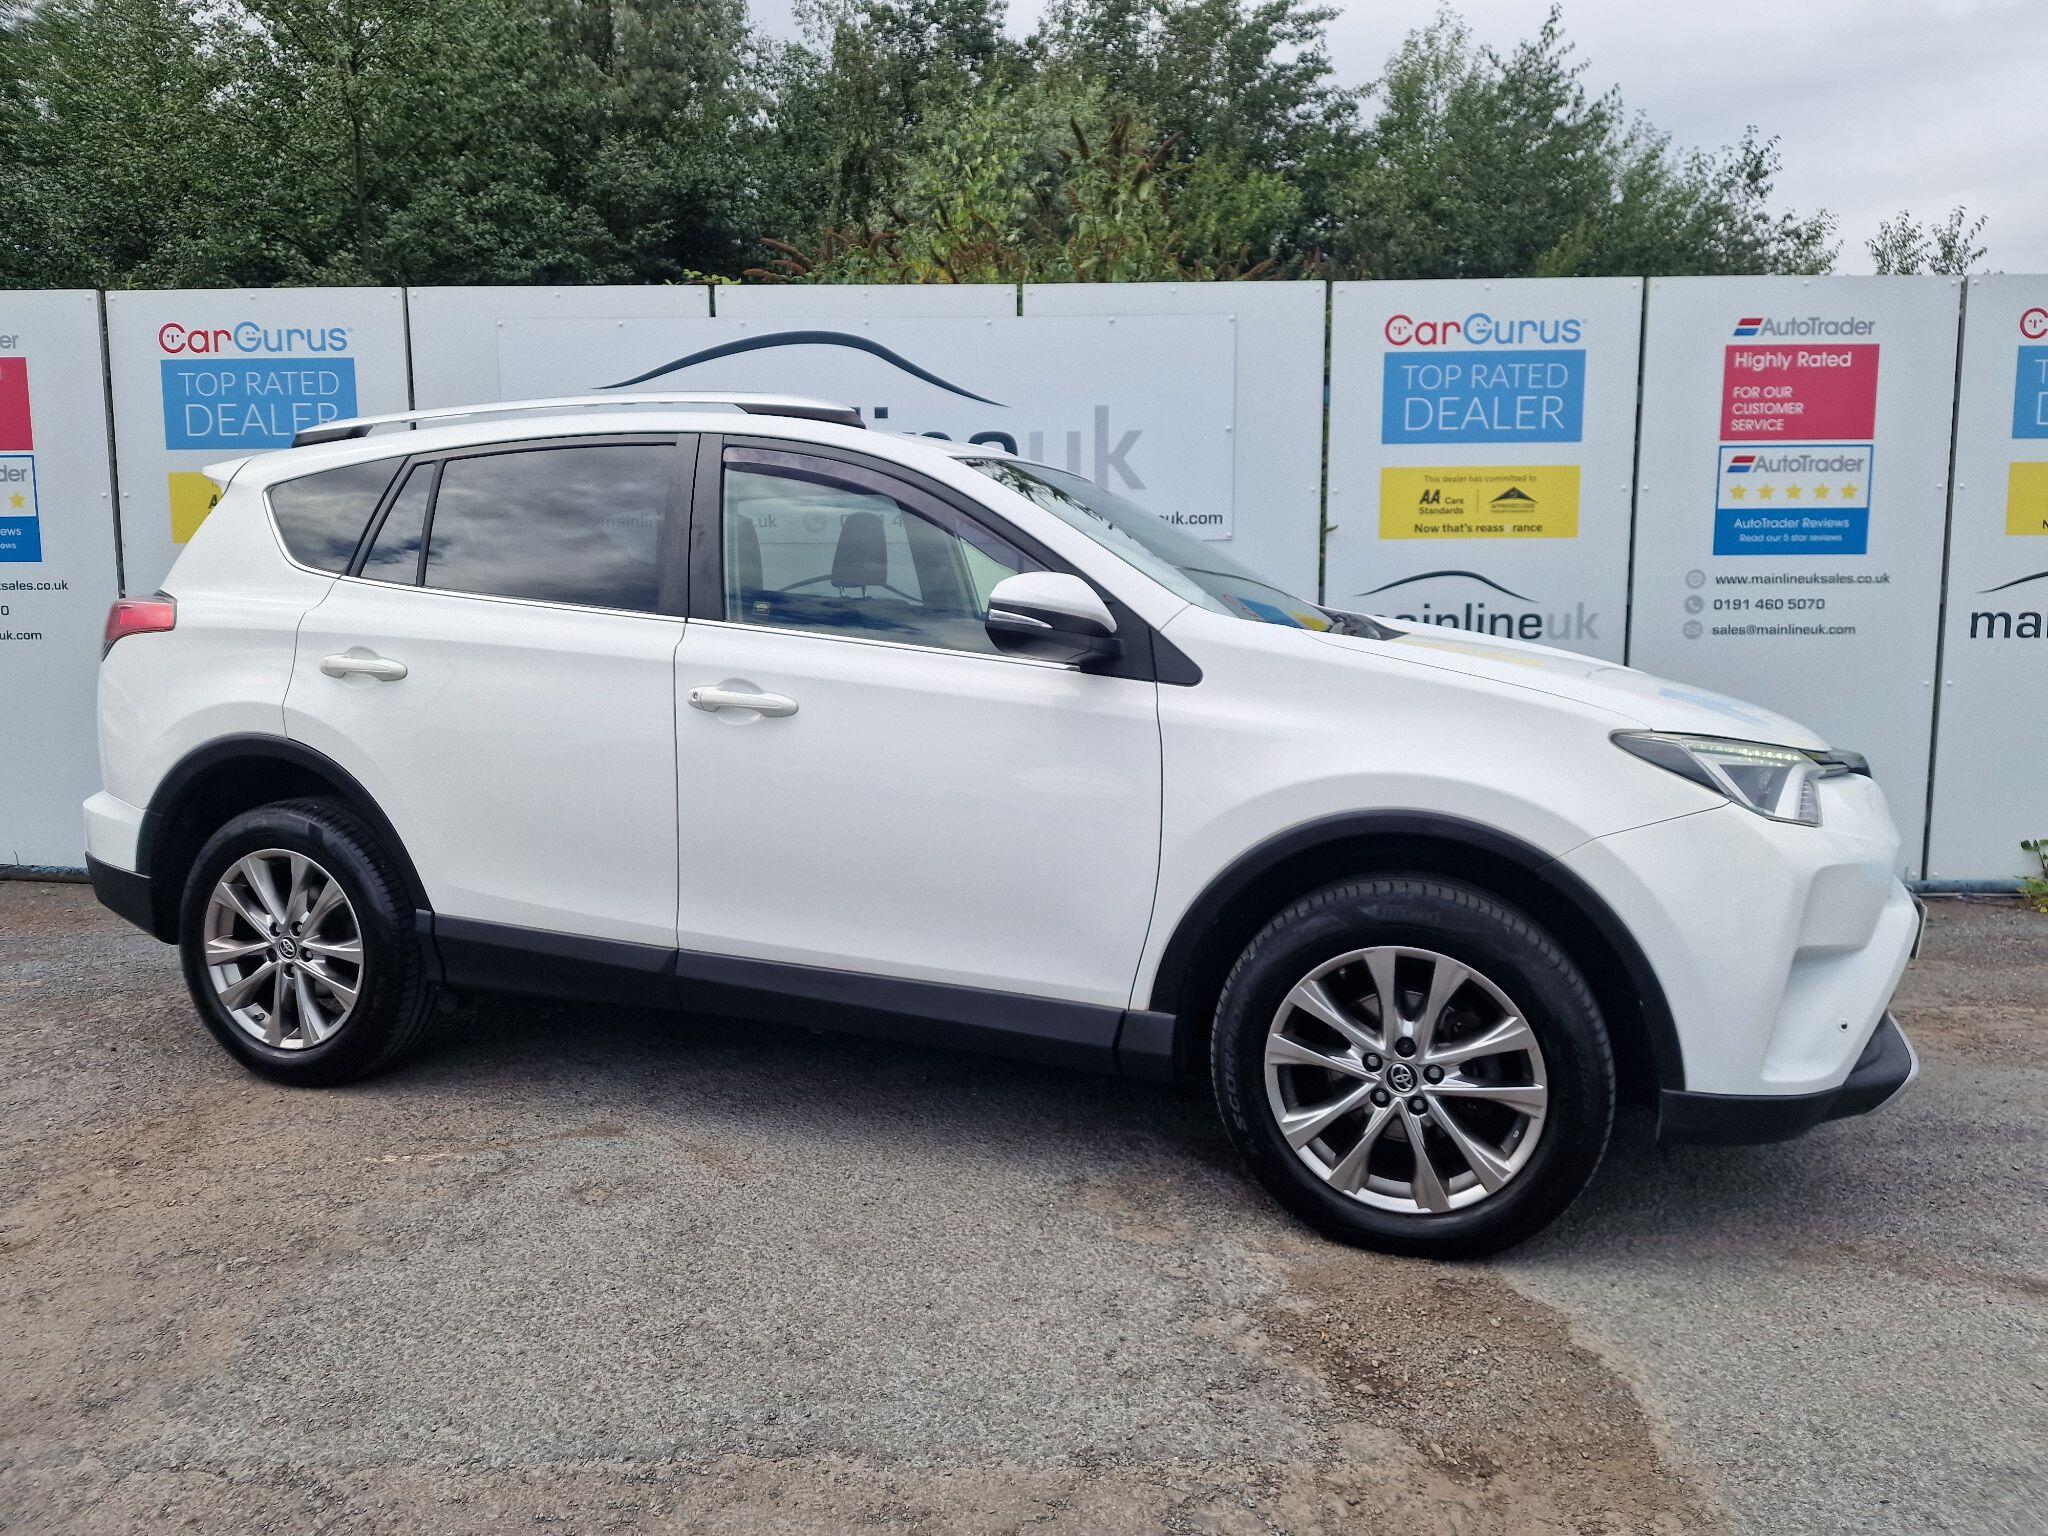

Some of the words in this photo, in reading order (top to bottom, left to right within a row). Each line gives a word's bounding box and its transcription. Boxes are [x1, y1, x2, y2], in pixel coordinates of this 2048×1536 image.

[1385, 312, 1582, 346] CarGurus
[1760, 317, 1875, 336] AutoTrader
[158, 321, 348, 354] CarGurus
[1734, 352, 1792, 371] Highly
[1797, 351, 1852, 368] Rated
[1402, 364, 1462, 390] TOP
[1471, 363, 1569, 389] RATED
[178, 371, 236, 397] TOP
[246, 370, 339, 396] RATED
[1733, 385, 1760, 399] FOR
[1763, 385, 1793, 399] OUR
[1404, 395, 1565, 431] DEALER
[1732, 402, 1804, 415] CUSTOMER
[1731, 418, 1785, 431] SERVICE
[1753, 455, 1864, 474] AutoTrader
[1442, 474, 1467, 482] dealer
[1469, 474, 1482, 482] has
[1485, 474, 1526, 482] committed
[1419, 489, 1441, 504] AA
[1419, 507, 1464, 515] Standards
[1414, 524, 1439, 533] Now
[1442, 523, 1473, 532] that's
[1734, 518, 1800, 529] AutoTrader
[1803, 518, 1850, 528] Reviews
[1739, 534, 1763, 542] Read
[1791, 534, 1808, 542] star
[1810, 533, 1843, 542] reviews
[1715, 573, 1891, 585] www.mainlineuksales.co.uk
[1713, 599, 1750, 611] 0191
[1755, 599, 1784, 610] 460
[1787, 598, 1826, 610] 5070
[1712, 624, 1856, 636] sales@mainlineuk.com
